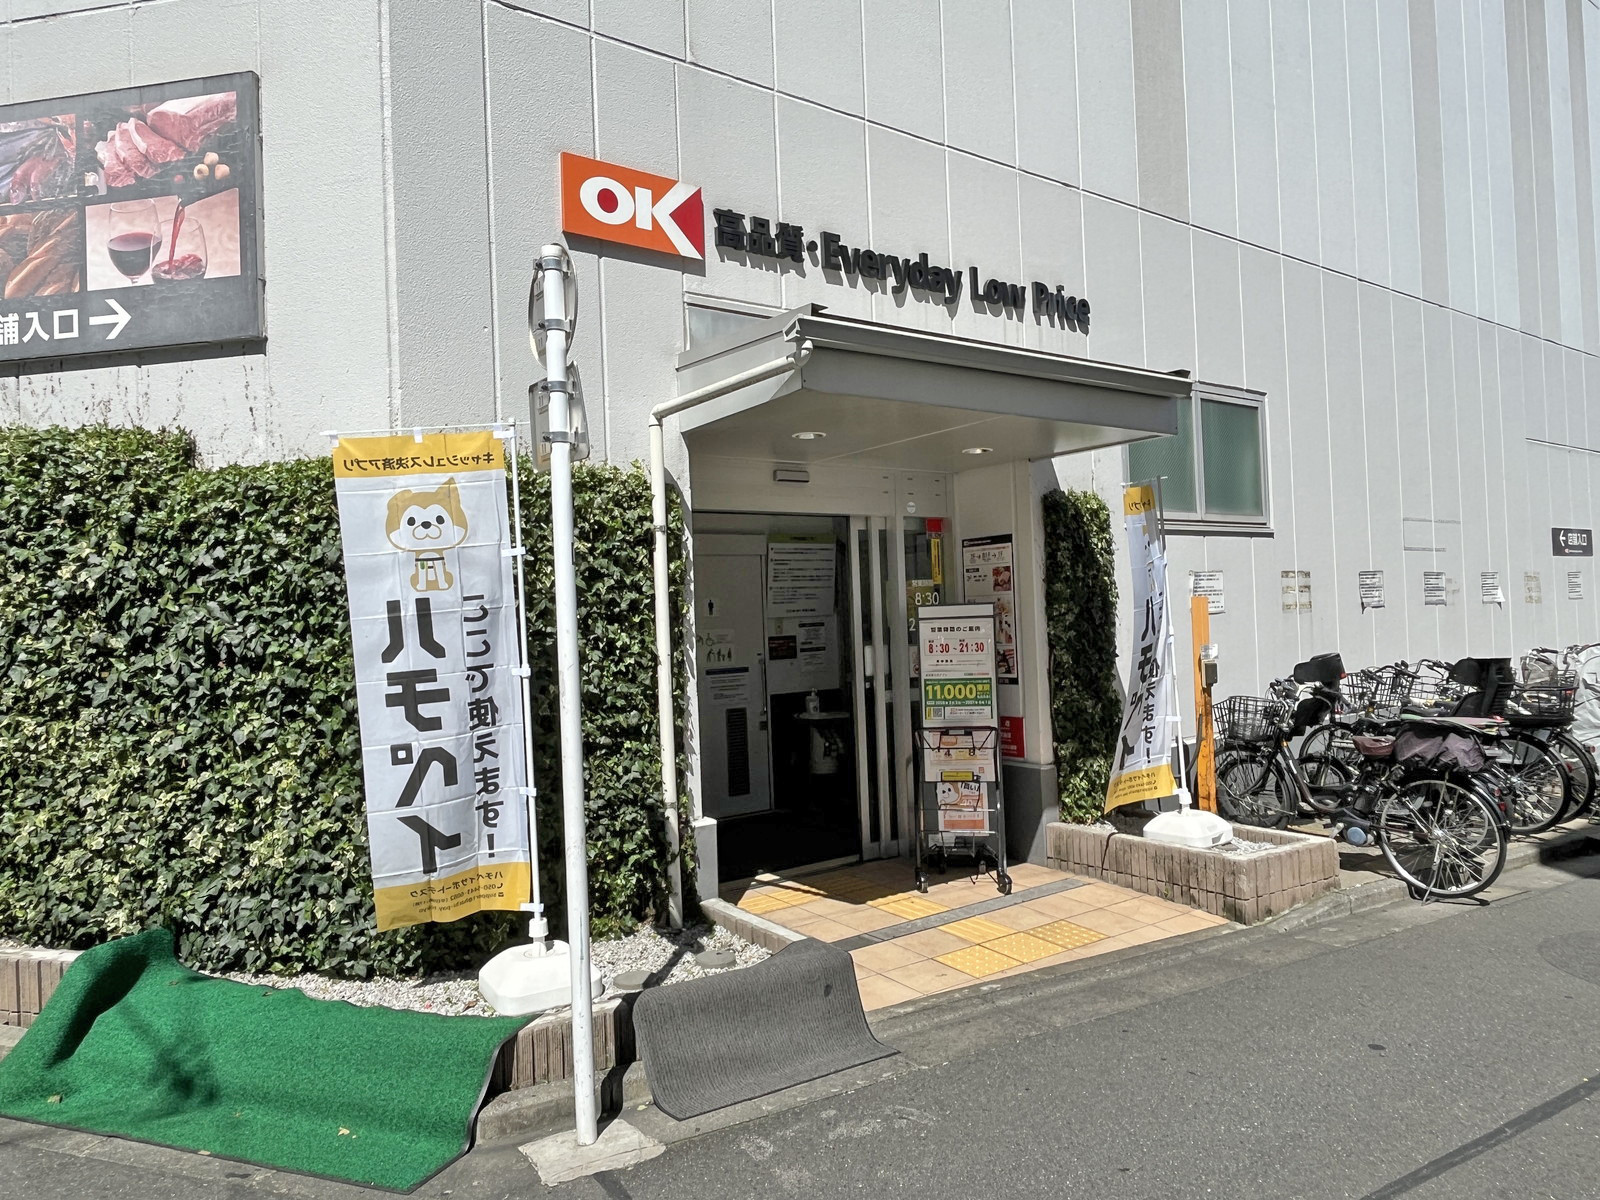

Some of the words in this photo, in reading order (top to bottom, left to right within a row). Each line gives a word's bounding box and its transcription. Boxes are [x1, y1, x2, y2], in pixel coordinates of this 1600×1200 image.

[579, 176, 703, 260] OK
[968, 266, 1025, 310] Low
[1031, 281, 1091, 324] Price
[928, 643, 950, 654] 8:30
[959, 642, 985, 653] 21:30
